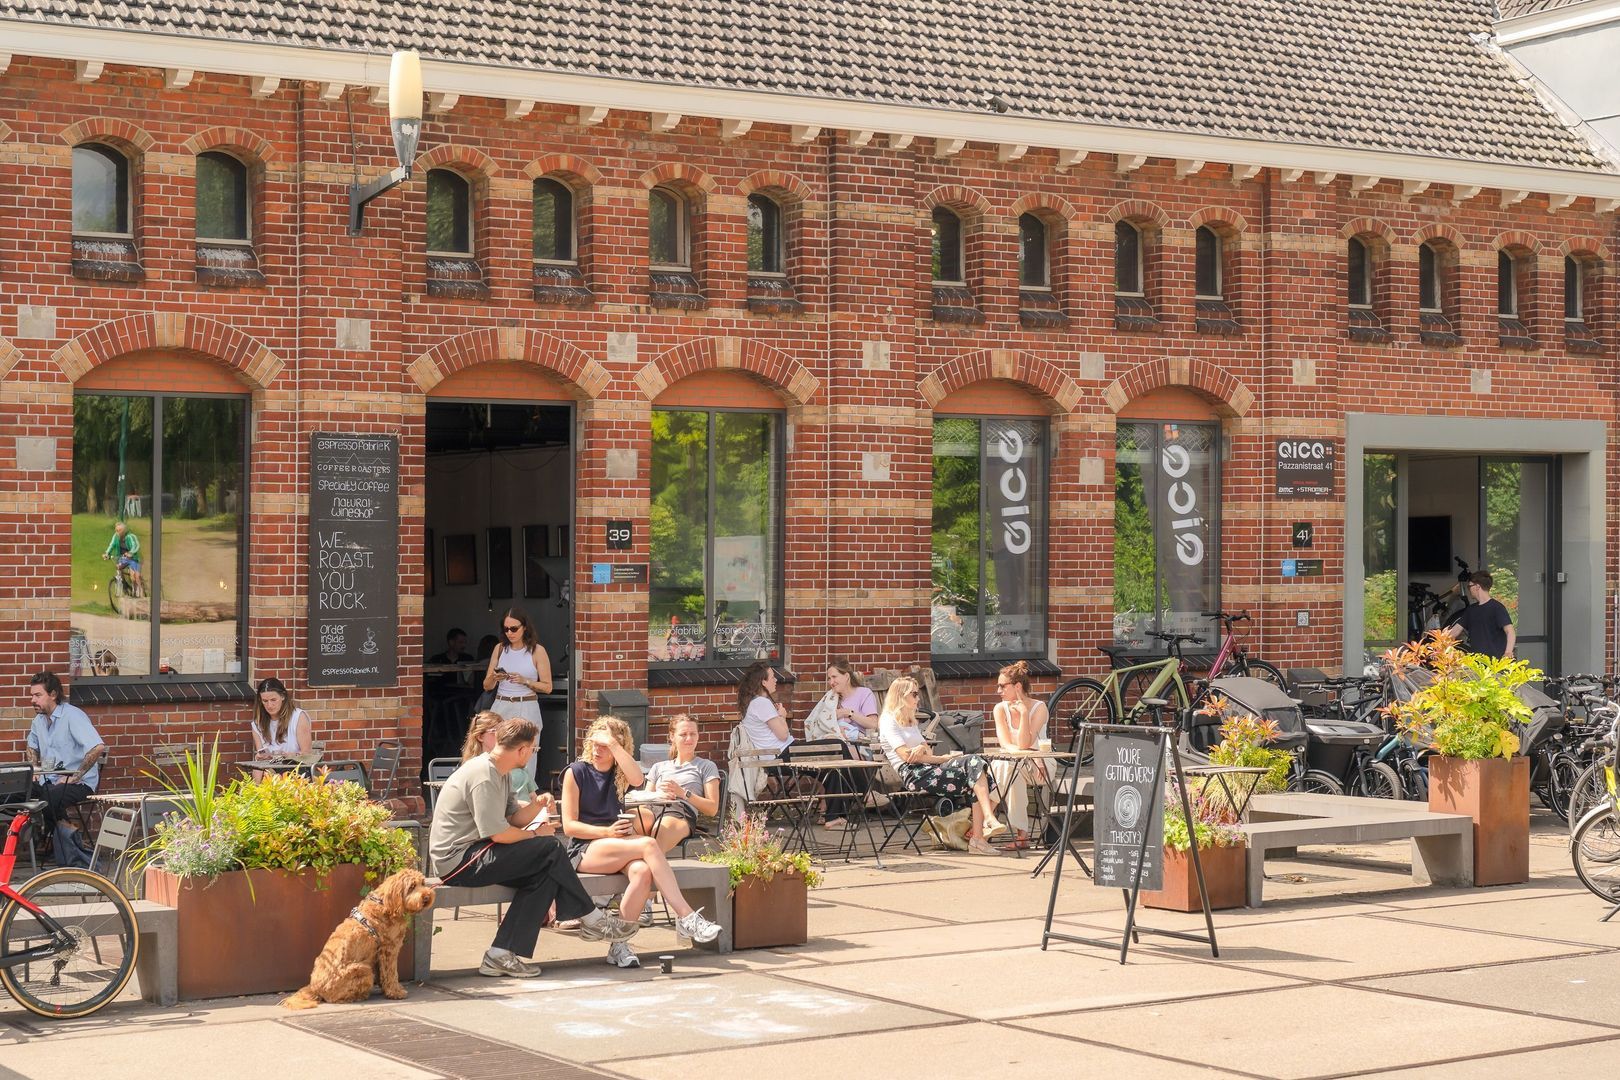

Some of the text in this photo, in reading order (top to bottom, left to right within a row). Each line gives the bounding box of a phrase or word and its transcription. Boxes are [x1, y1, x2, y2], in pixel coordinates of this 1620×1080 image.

[1278, 442, 1324, 458] QiCQ
[351, 465, 391, 474] ROASTERS
[1278, 462, 1324, 470] Pazzanistraat
[318, 531, 343, 548] WE
[609, 530, 630, 541] 39
[1297, 530, 1309, 540] 41
[318, 571, 354, 590] YOU
[1106, 764, 1154, 784] GETTING VERY
